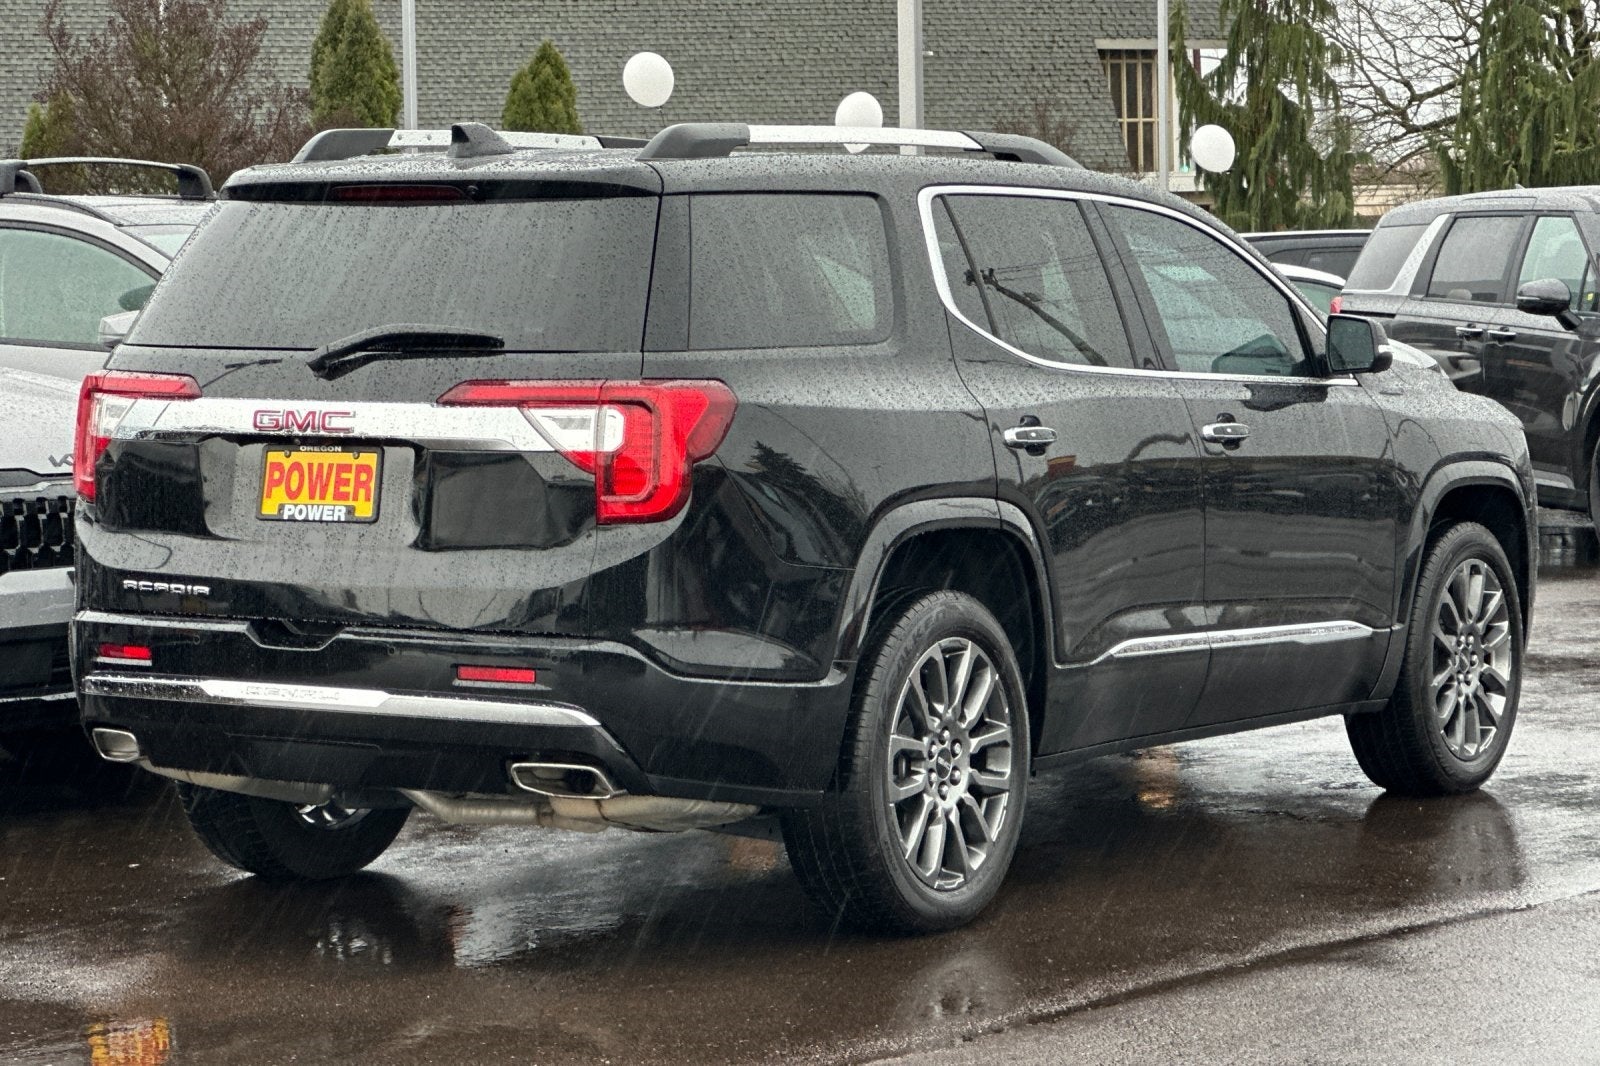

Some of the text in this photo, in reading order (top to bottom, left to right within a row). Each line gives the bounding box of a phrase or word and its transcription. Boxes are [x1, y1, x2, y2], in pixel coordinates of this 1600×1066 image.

[253, 409, 355, 433] GMC
[265, 461, 374, 502] POWER
[282, 504, 347, 521] POWER
[123, 579, 210, 595] ACADIA
